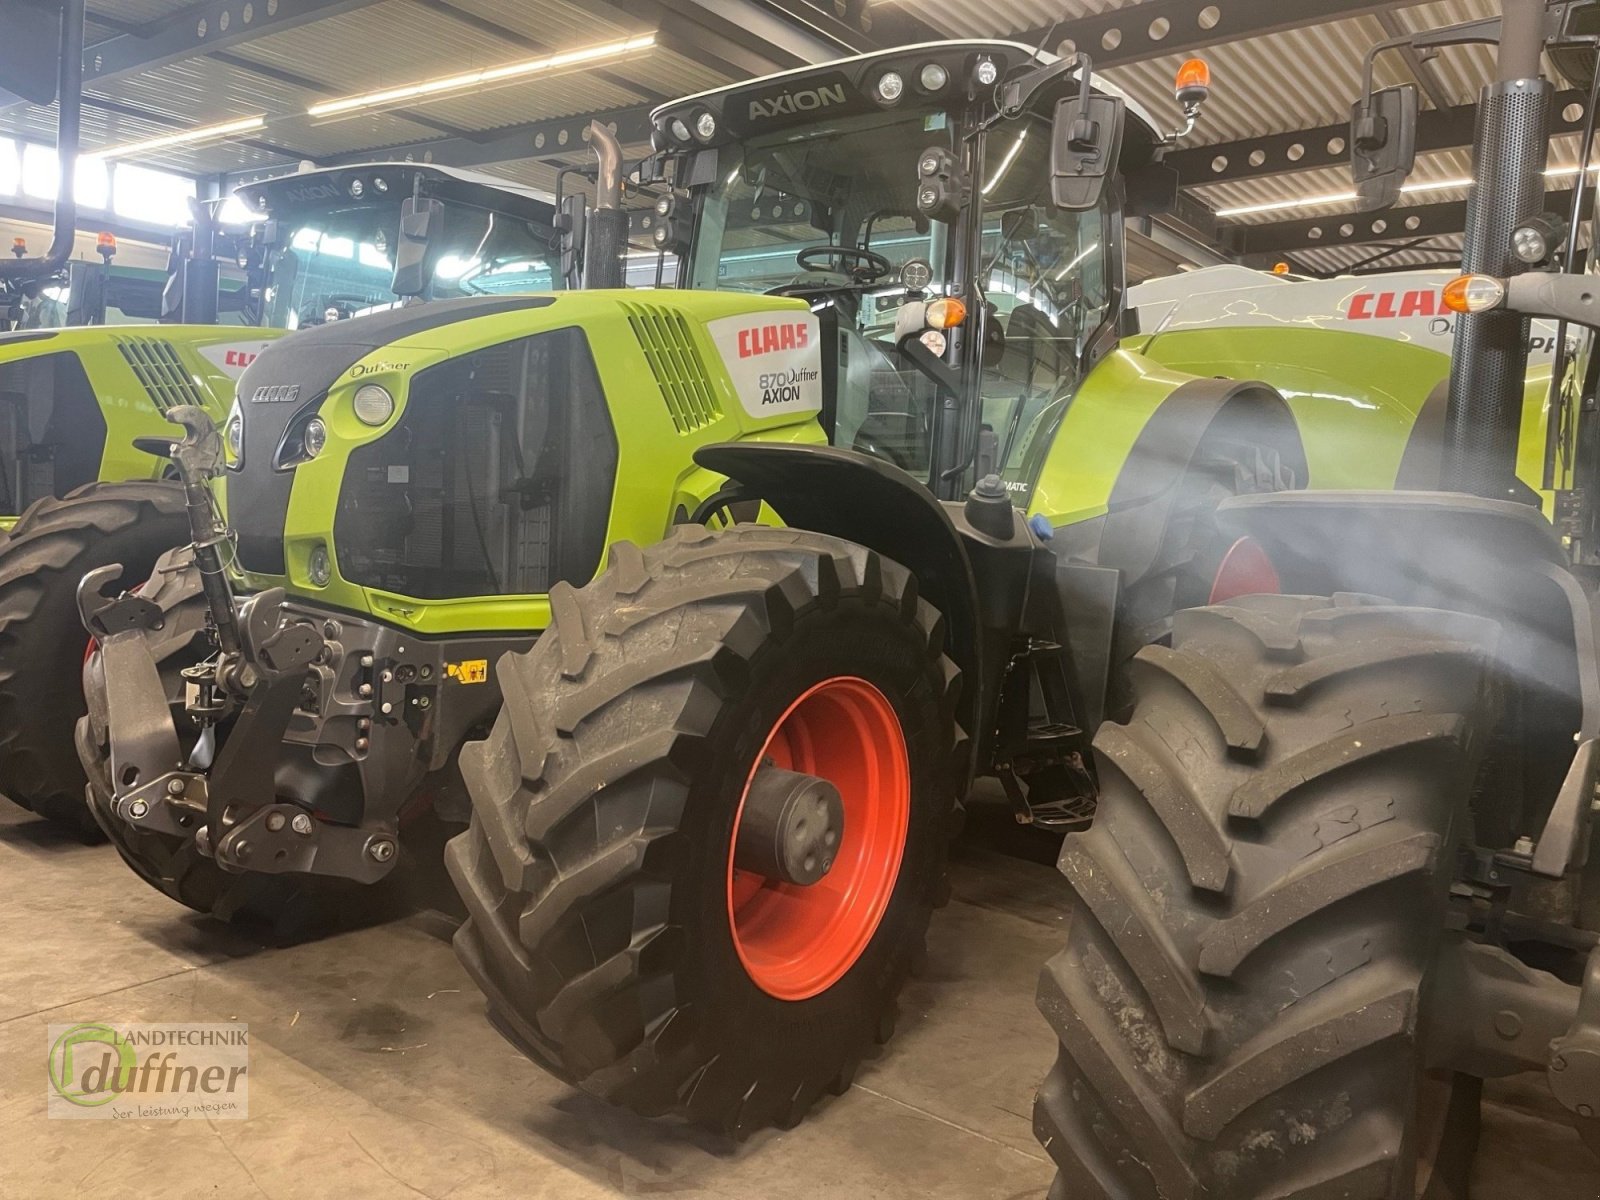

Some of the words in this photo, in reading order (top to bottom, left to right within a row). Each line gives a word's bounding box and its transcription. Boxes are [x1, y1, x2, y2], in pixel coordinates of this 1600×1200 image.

[749, 83, 846, 120] AXION
[738, 323, 808, 359] CLAAS
[759, 373, 786, 389] 870
[252, 384, 299, 403] CLAAS
[762, 386, 800, 405] AXION
